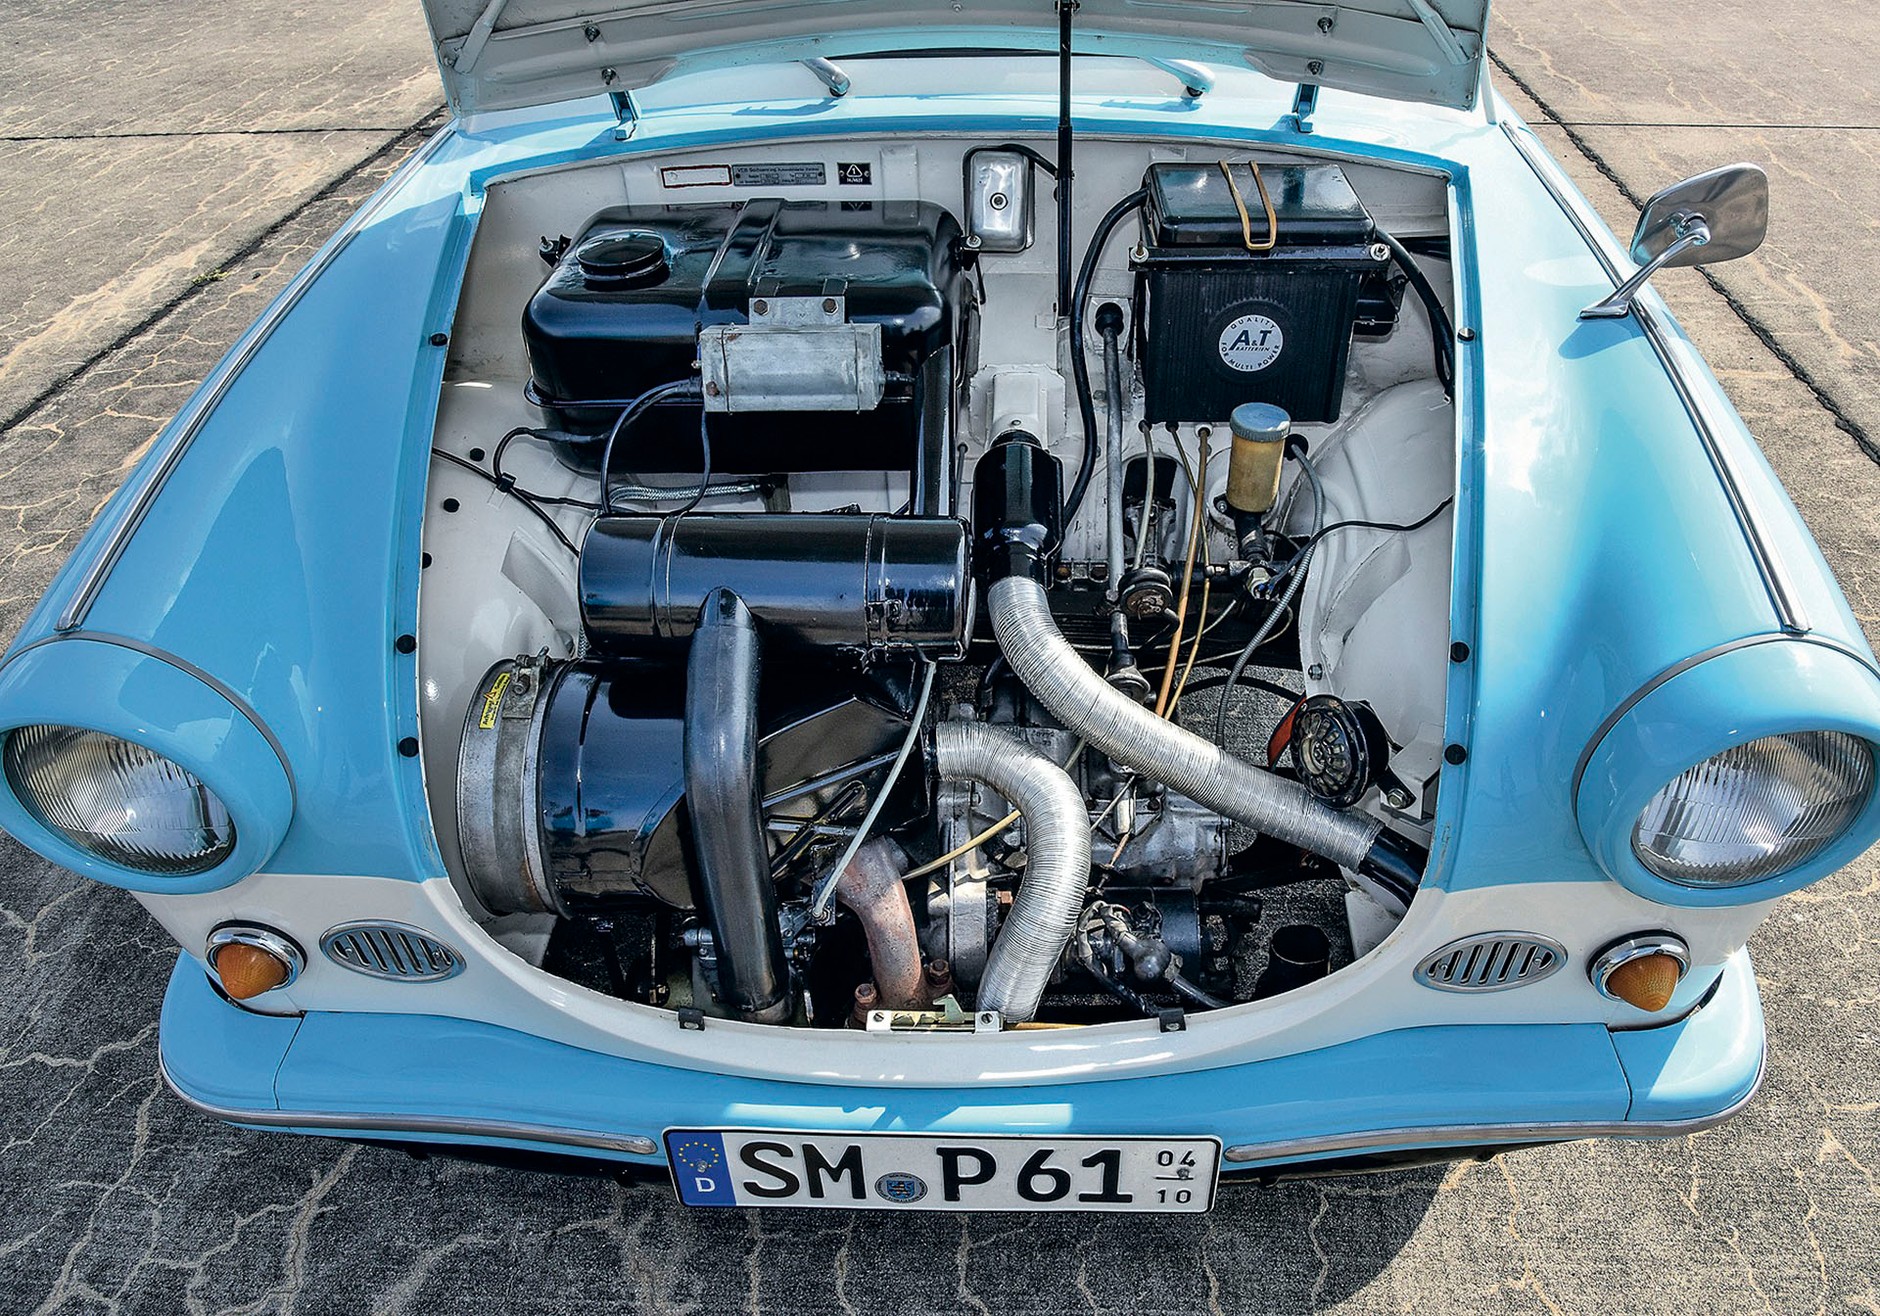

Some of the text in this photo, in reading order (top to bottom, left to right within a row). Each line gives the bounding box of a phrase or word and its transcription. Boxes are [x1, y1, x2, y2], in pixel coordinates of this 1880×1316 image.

[1230, 317, 1276, 330] QUALITY
[1228, 330, 1272, 351] A&T
[1221, 342, 1280, 370] FOR MULTI POWER
[1158, 1151, 1196, 1168] 04
[739, 1141, 868, 1200] SM
[935, 1146, 998, 1202] P
[1016, 1149, 1133, 1203] 61
[695, 1176, 715, 1194] D
[1157, 1189, 1193, 1204] 10
